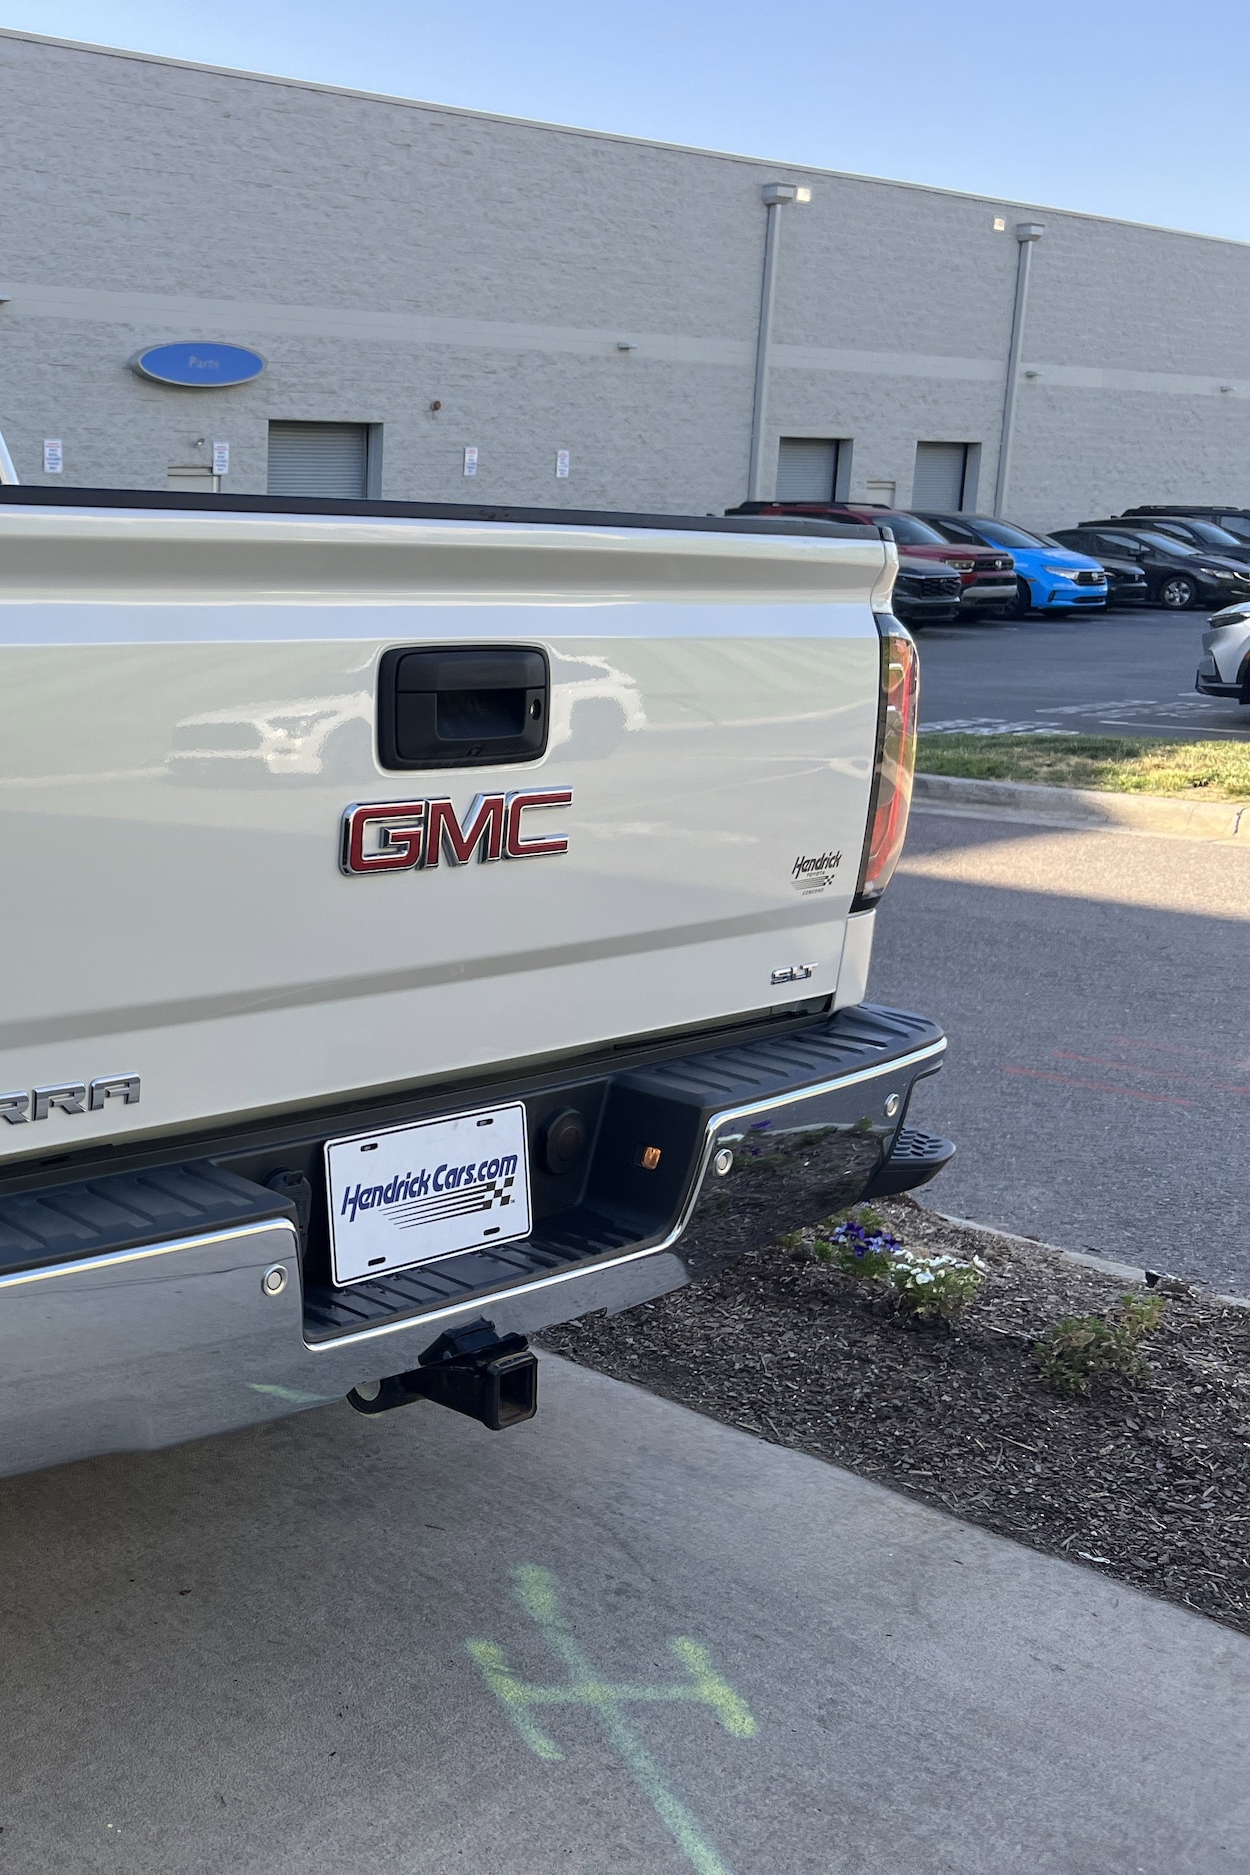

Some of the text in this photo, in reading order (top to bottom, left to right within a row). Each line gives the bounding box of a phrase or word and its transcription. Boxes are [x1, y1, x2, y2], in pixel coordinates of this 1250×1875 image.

[188, 356, 221, 369] Parts
[338, 785, 574, 877] GMC
[791, 850, 843, 880] Hendrick
[770, 961, 819, 985] SLT
